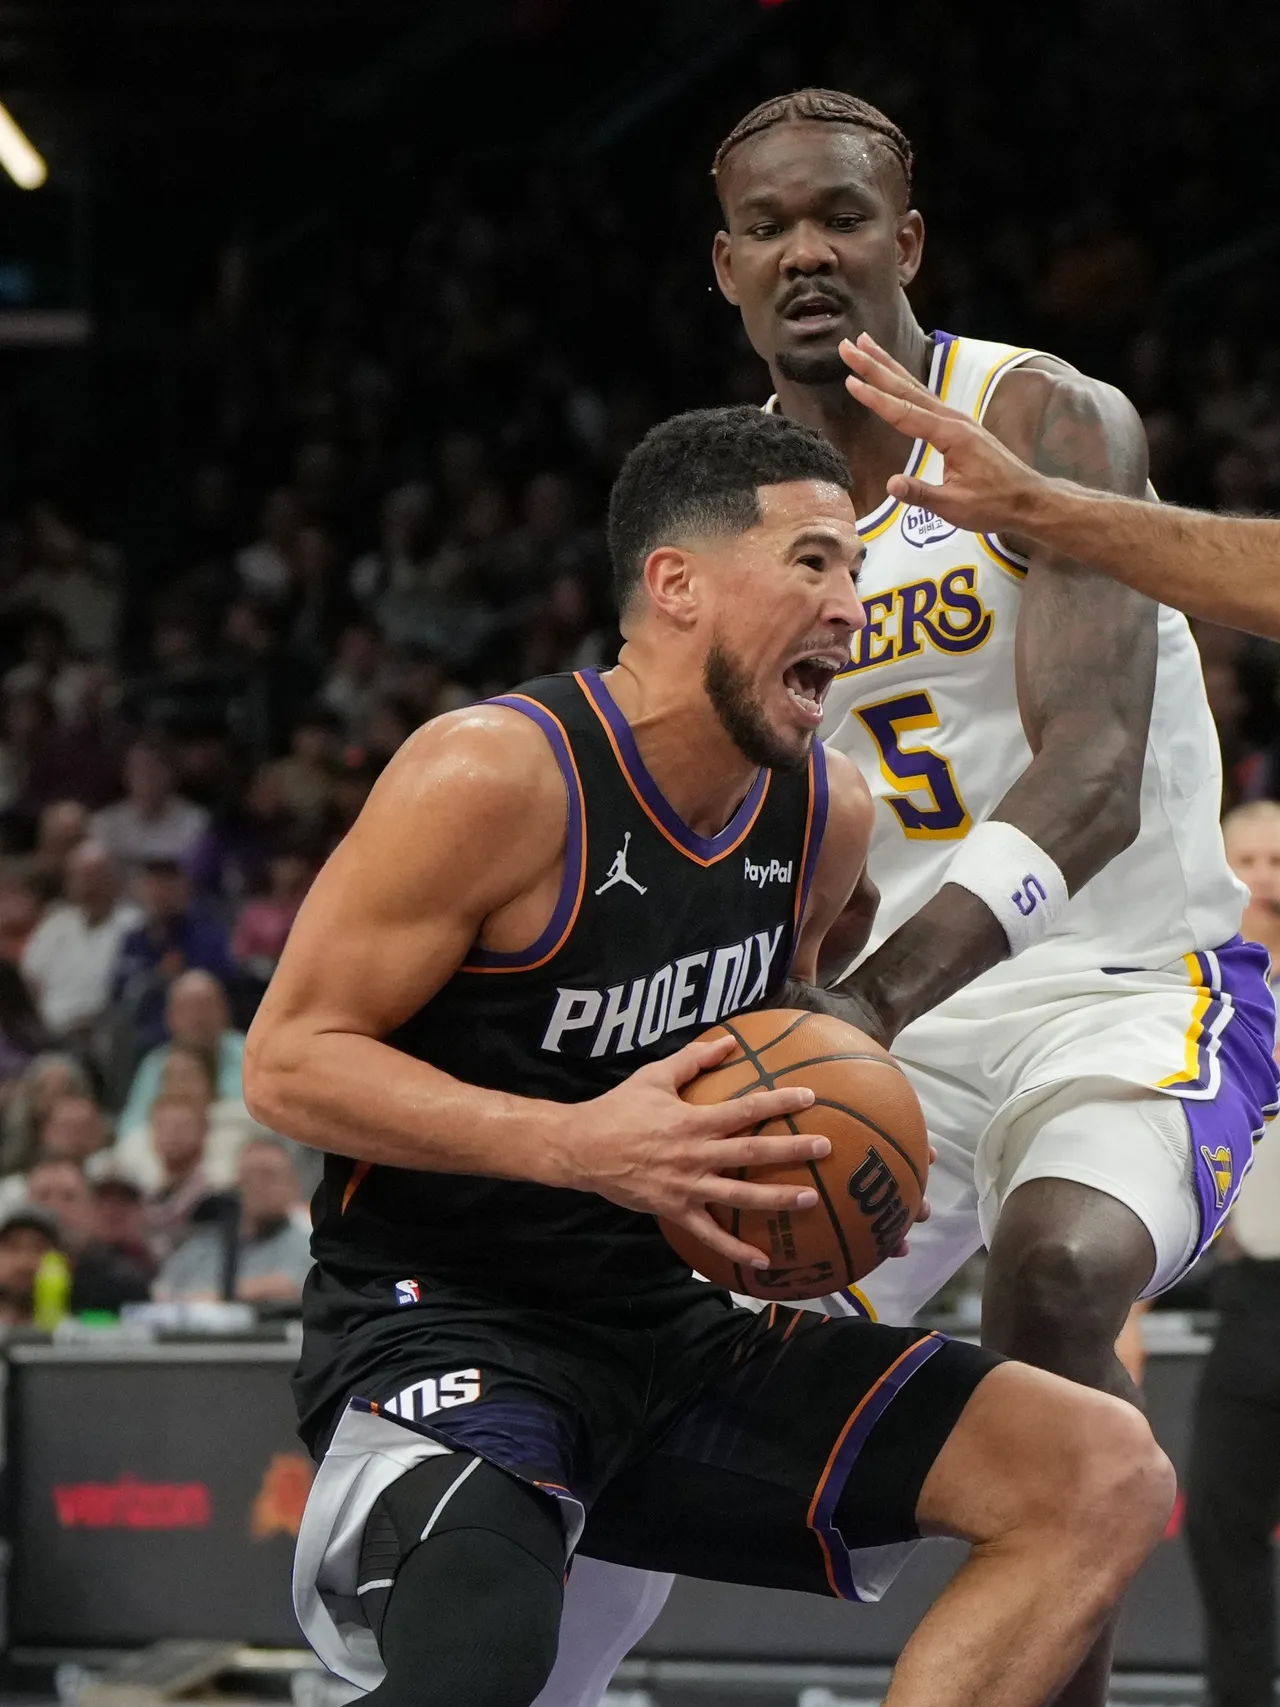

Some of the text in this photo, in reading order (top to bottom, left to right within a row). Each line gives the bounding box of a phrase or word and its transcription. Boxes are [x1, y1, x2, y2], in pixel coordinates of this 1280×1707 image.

[906, 507, 935, 531] bib
[835, 565, 995, 679] ERS
[851, 688, 974, 841] 5
[744, 857, 793, 888] PayPal
[540, 923, 785, 1058] PHOENIX
